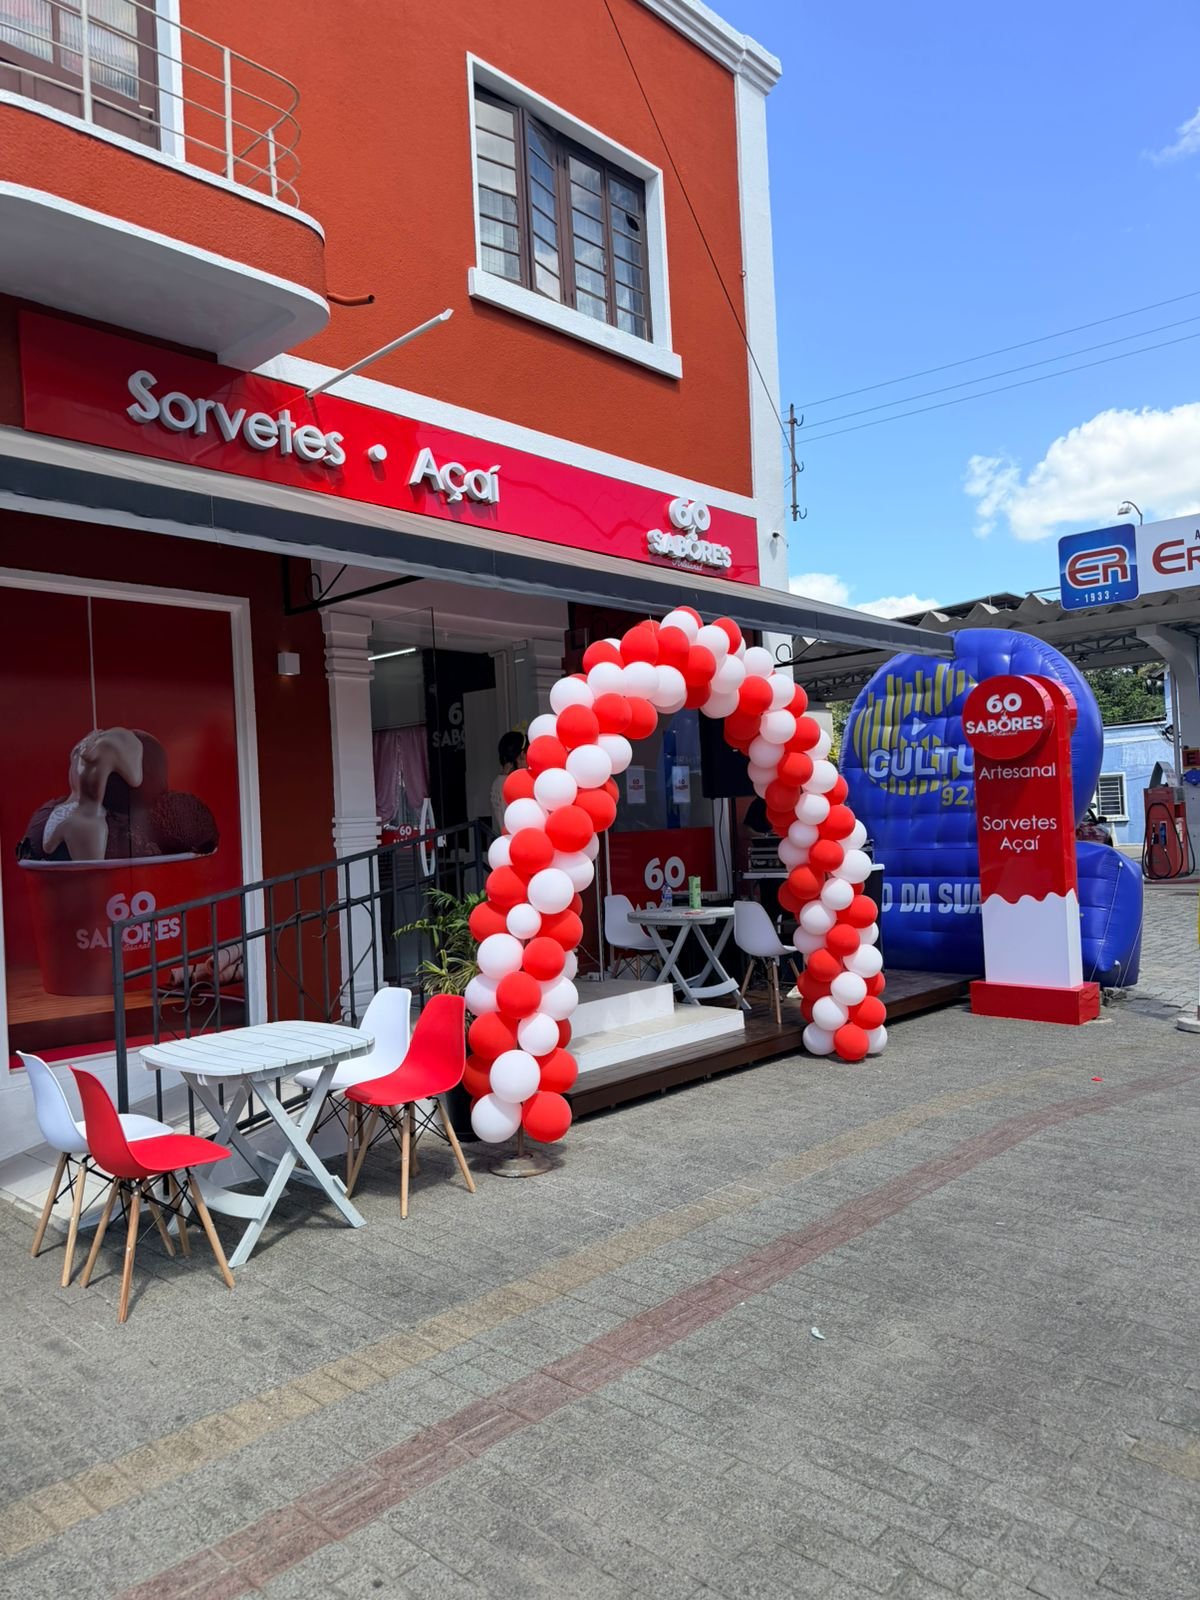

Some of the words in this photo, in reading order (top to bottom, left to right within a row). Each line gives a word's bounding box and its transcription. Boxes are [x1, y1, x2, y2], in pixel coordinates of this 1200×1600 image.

[126, 370, 346, 467] Sorvetes
[408, 446, 501, 504] Açaí
[668, 498, 711, 531] 60
[646, 529, 732, 568] SABORES
[1065, 544, 1131, 589] ER
[1084, 590, 1110, 603] 1933
[986, 692, 1023, 714] 60
[965, 715, 1044, 734] SABORES
[868, 744, 975, 778] CULTU
[978, 762, 1056, 780] Artesanal
[400, 825, 412, 836] 60
[982, 815, 1057, 831] Sorvetes
[1000, 834, 1040, 853] Açaí
[644, 856, 685, 890] 60
[106, 890, 156, 922] 60
[900, 883, 931, 913] DA
[938, 883, 982, 914] SUA
